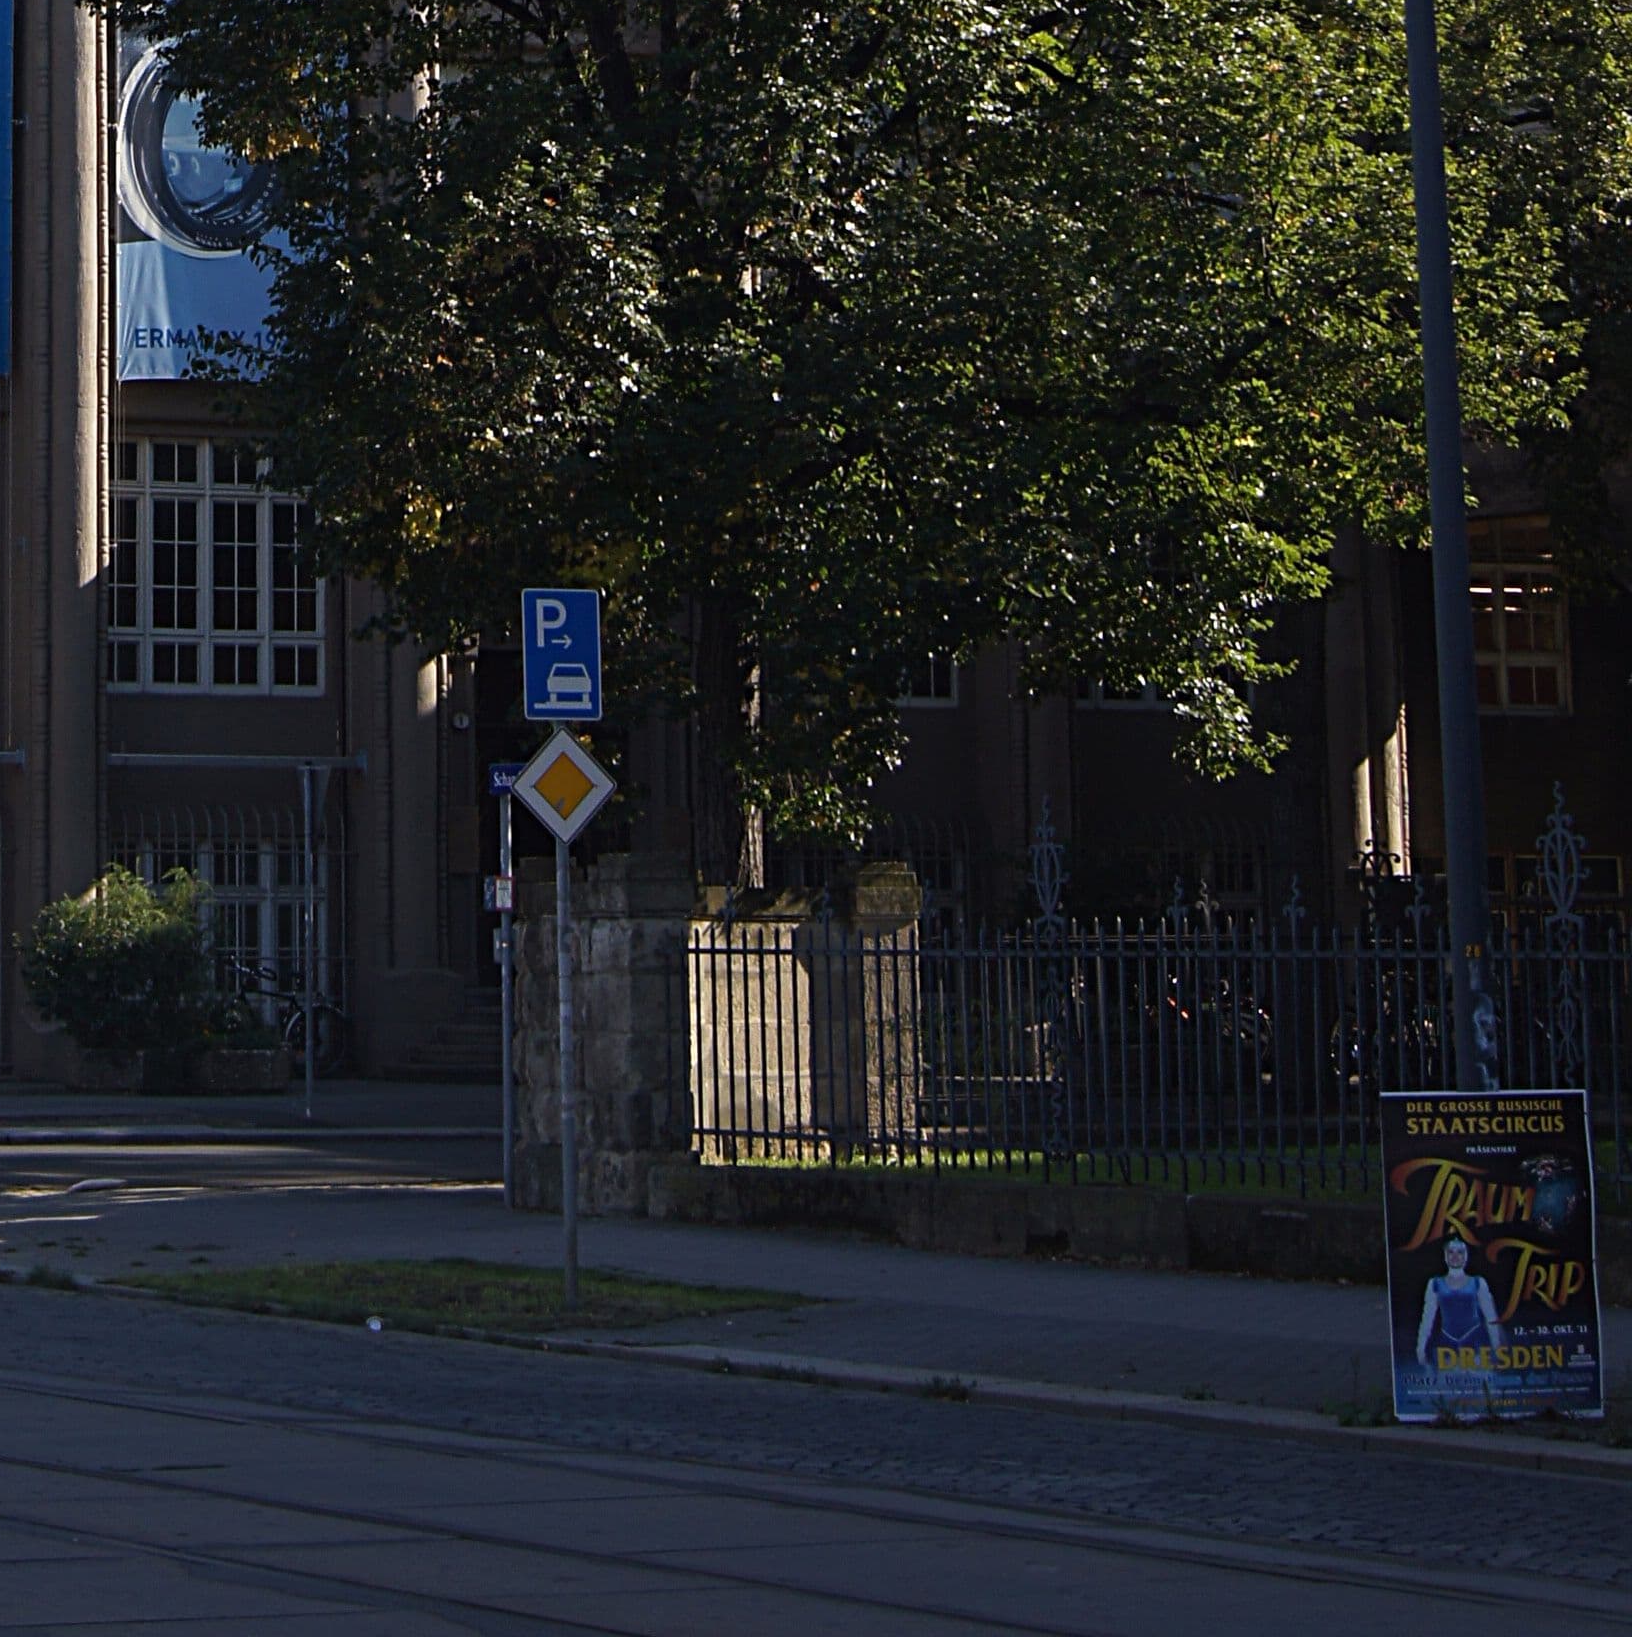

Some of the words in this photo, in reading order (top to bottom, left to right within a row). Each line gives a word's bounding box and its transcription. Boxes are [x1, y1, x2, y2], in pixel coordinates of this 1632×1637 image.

[536, 598, 567, 648] P
[1406, 1101, 1433, 1113] DER
[1439, 1100, 1492, 1113] GROSSE
[1497, 1099, 1563, 1111] RUSSISCHE
[1407, 1115, 1565, 1135] STAATSCIRCUS
[1437, 1344, 1565, 1370] DRESDEN
